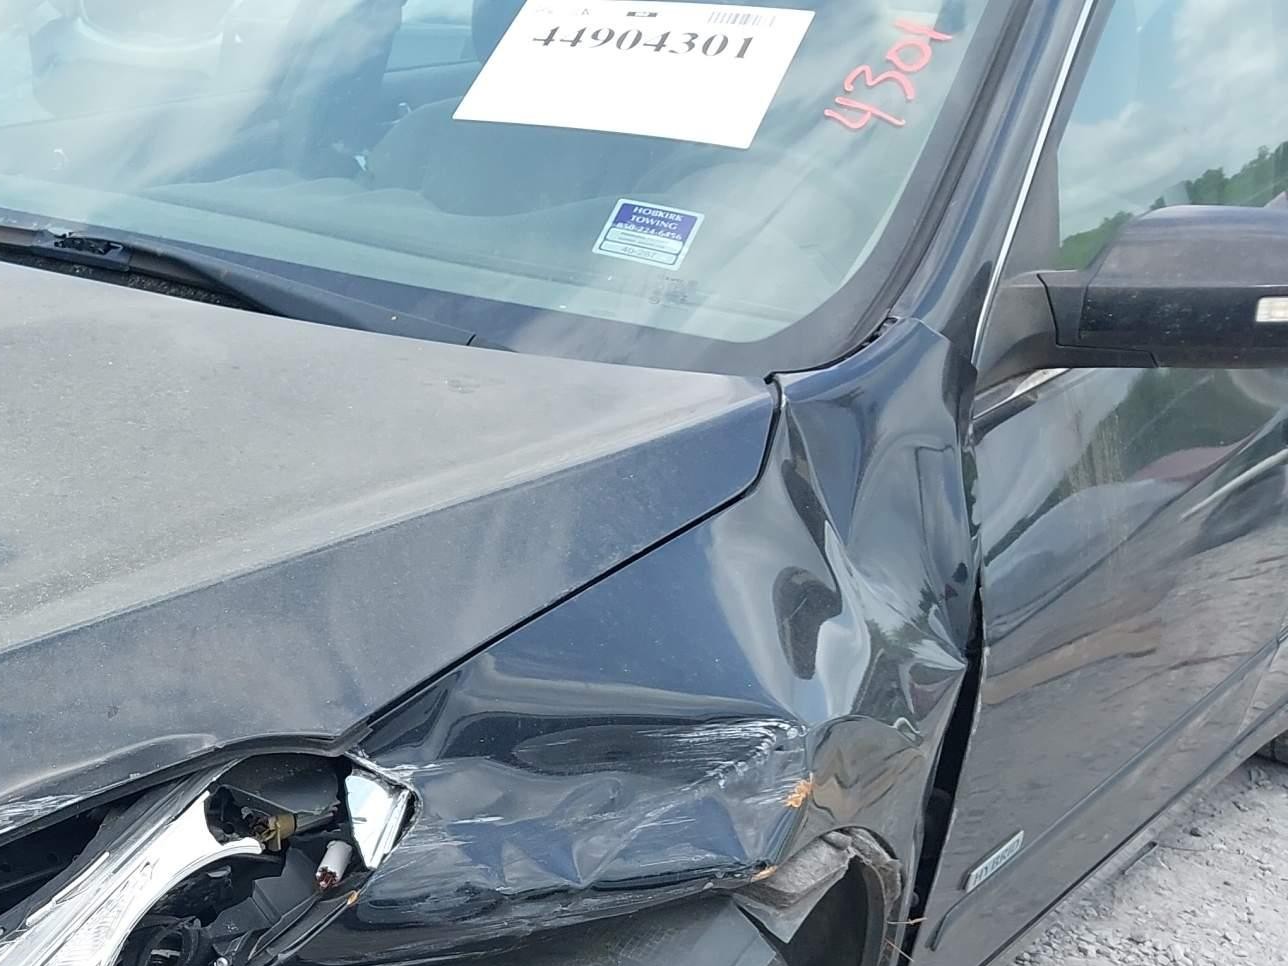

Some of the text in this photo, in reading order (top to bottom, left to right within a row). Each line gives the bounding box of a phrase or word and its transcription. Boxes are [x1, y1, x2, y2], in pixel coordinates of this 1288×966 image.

[531, 26, 754, 59] 44904301
[823, 18, 953, 129] 4301
[630, 214, 679, 231] TOWING
